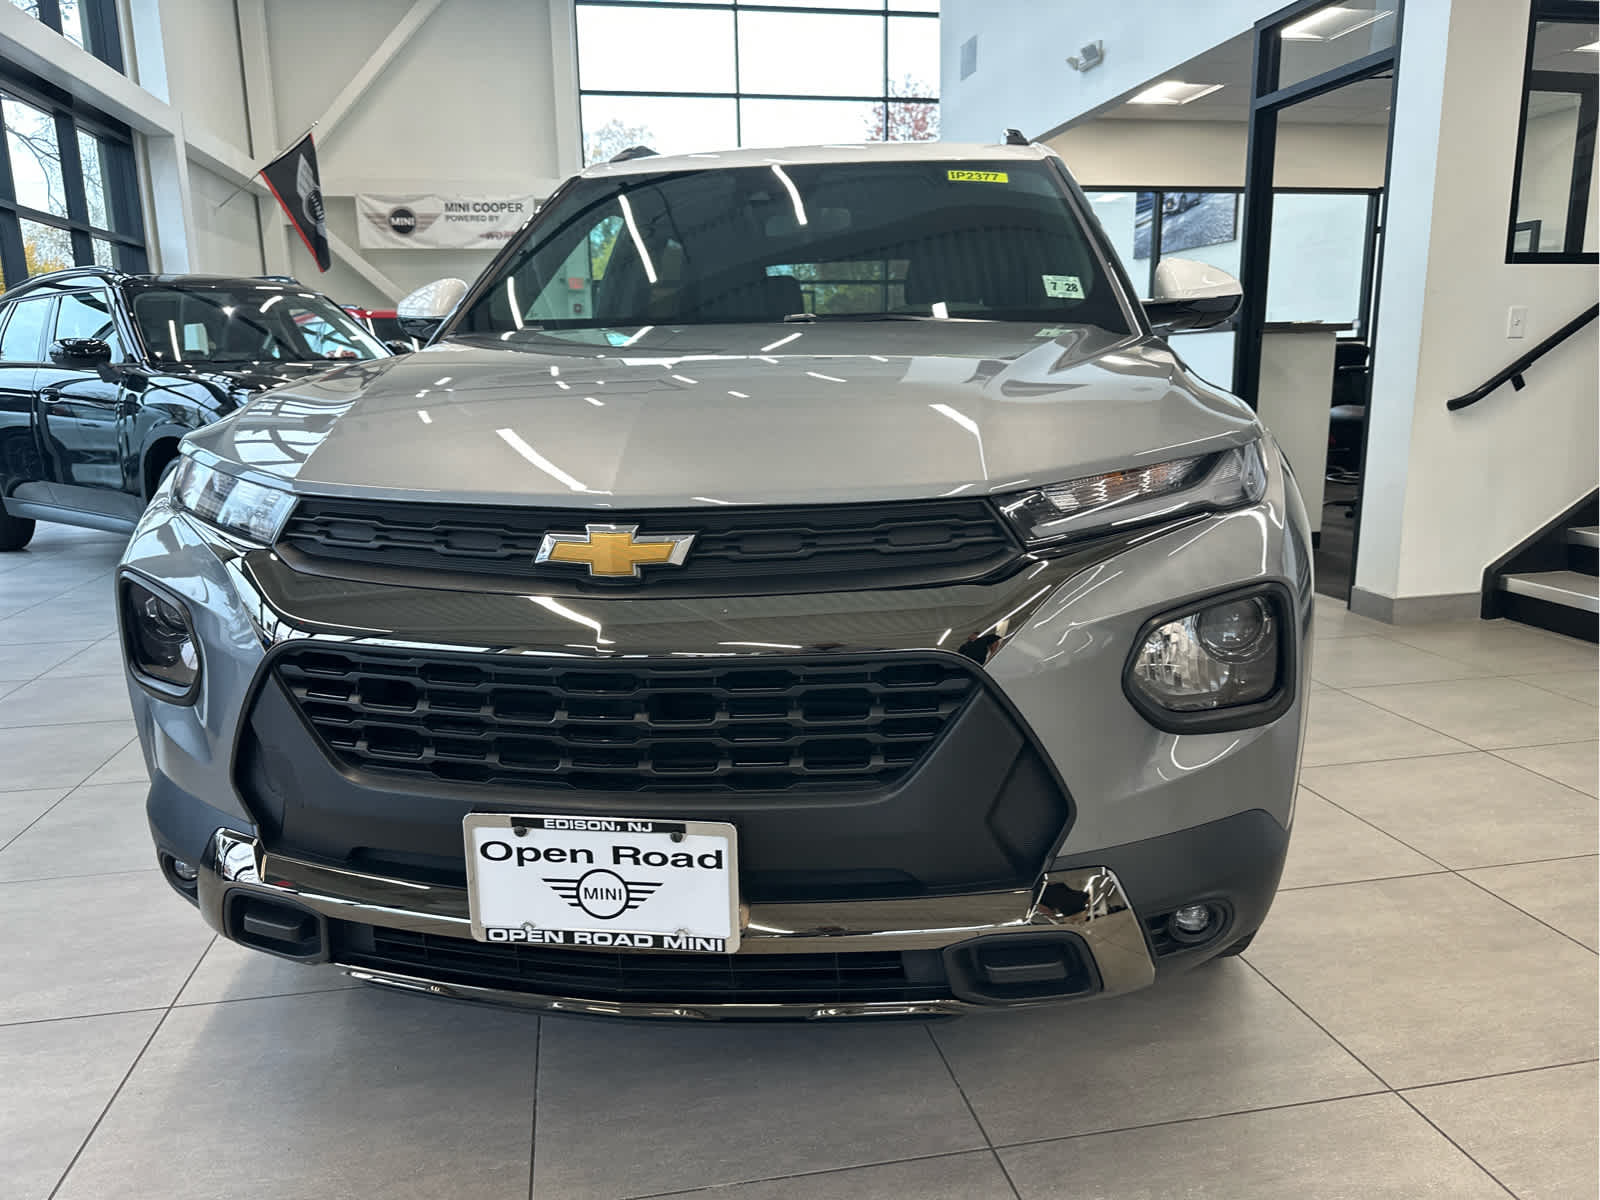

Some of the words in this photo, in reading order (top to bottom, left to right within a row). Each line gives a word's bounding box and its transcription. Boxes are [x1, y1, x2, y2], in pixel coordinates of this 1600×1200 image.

[444, 202, 470, 213] MINI
[471, 202, 524, 213] COOPER
[390, 216, 415, 226] MINI
[444, 215, 487, 223] POWERED
[488, 215, 499, 223] BY
[1050, 281, 1057, 291] 7
[1064, 282, 1079, 292] 28
[543, 818, 621, 832] EDISON,
[627, 821, 653, 833] NJ
[479, 840, 595, 867] Open
[611, 844, 724, 870] Road
[583, 886, 623, 901] MINI
[487, 928, 565, 944] OPEN
[573, 931, 654, 948] ROAD
[662, 935, 725, 952] MINI
